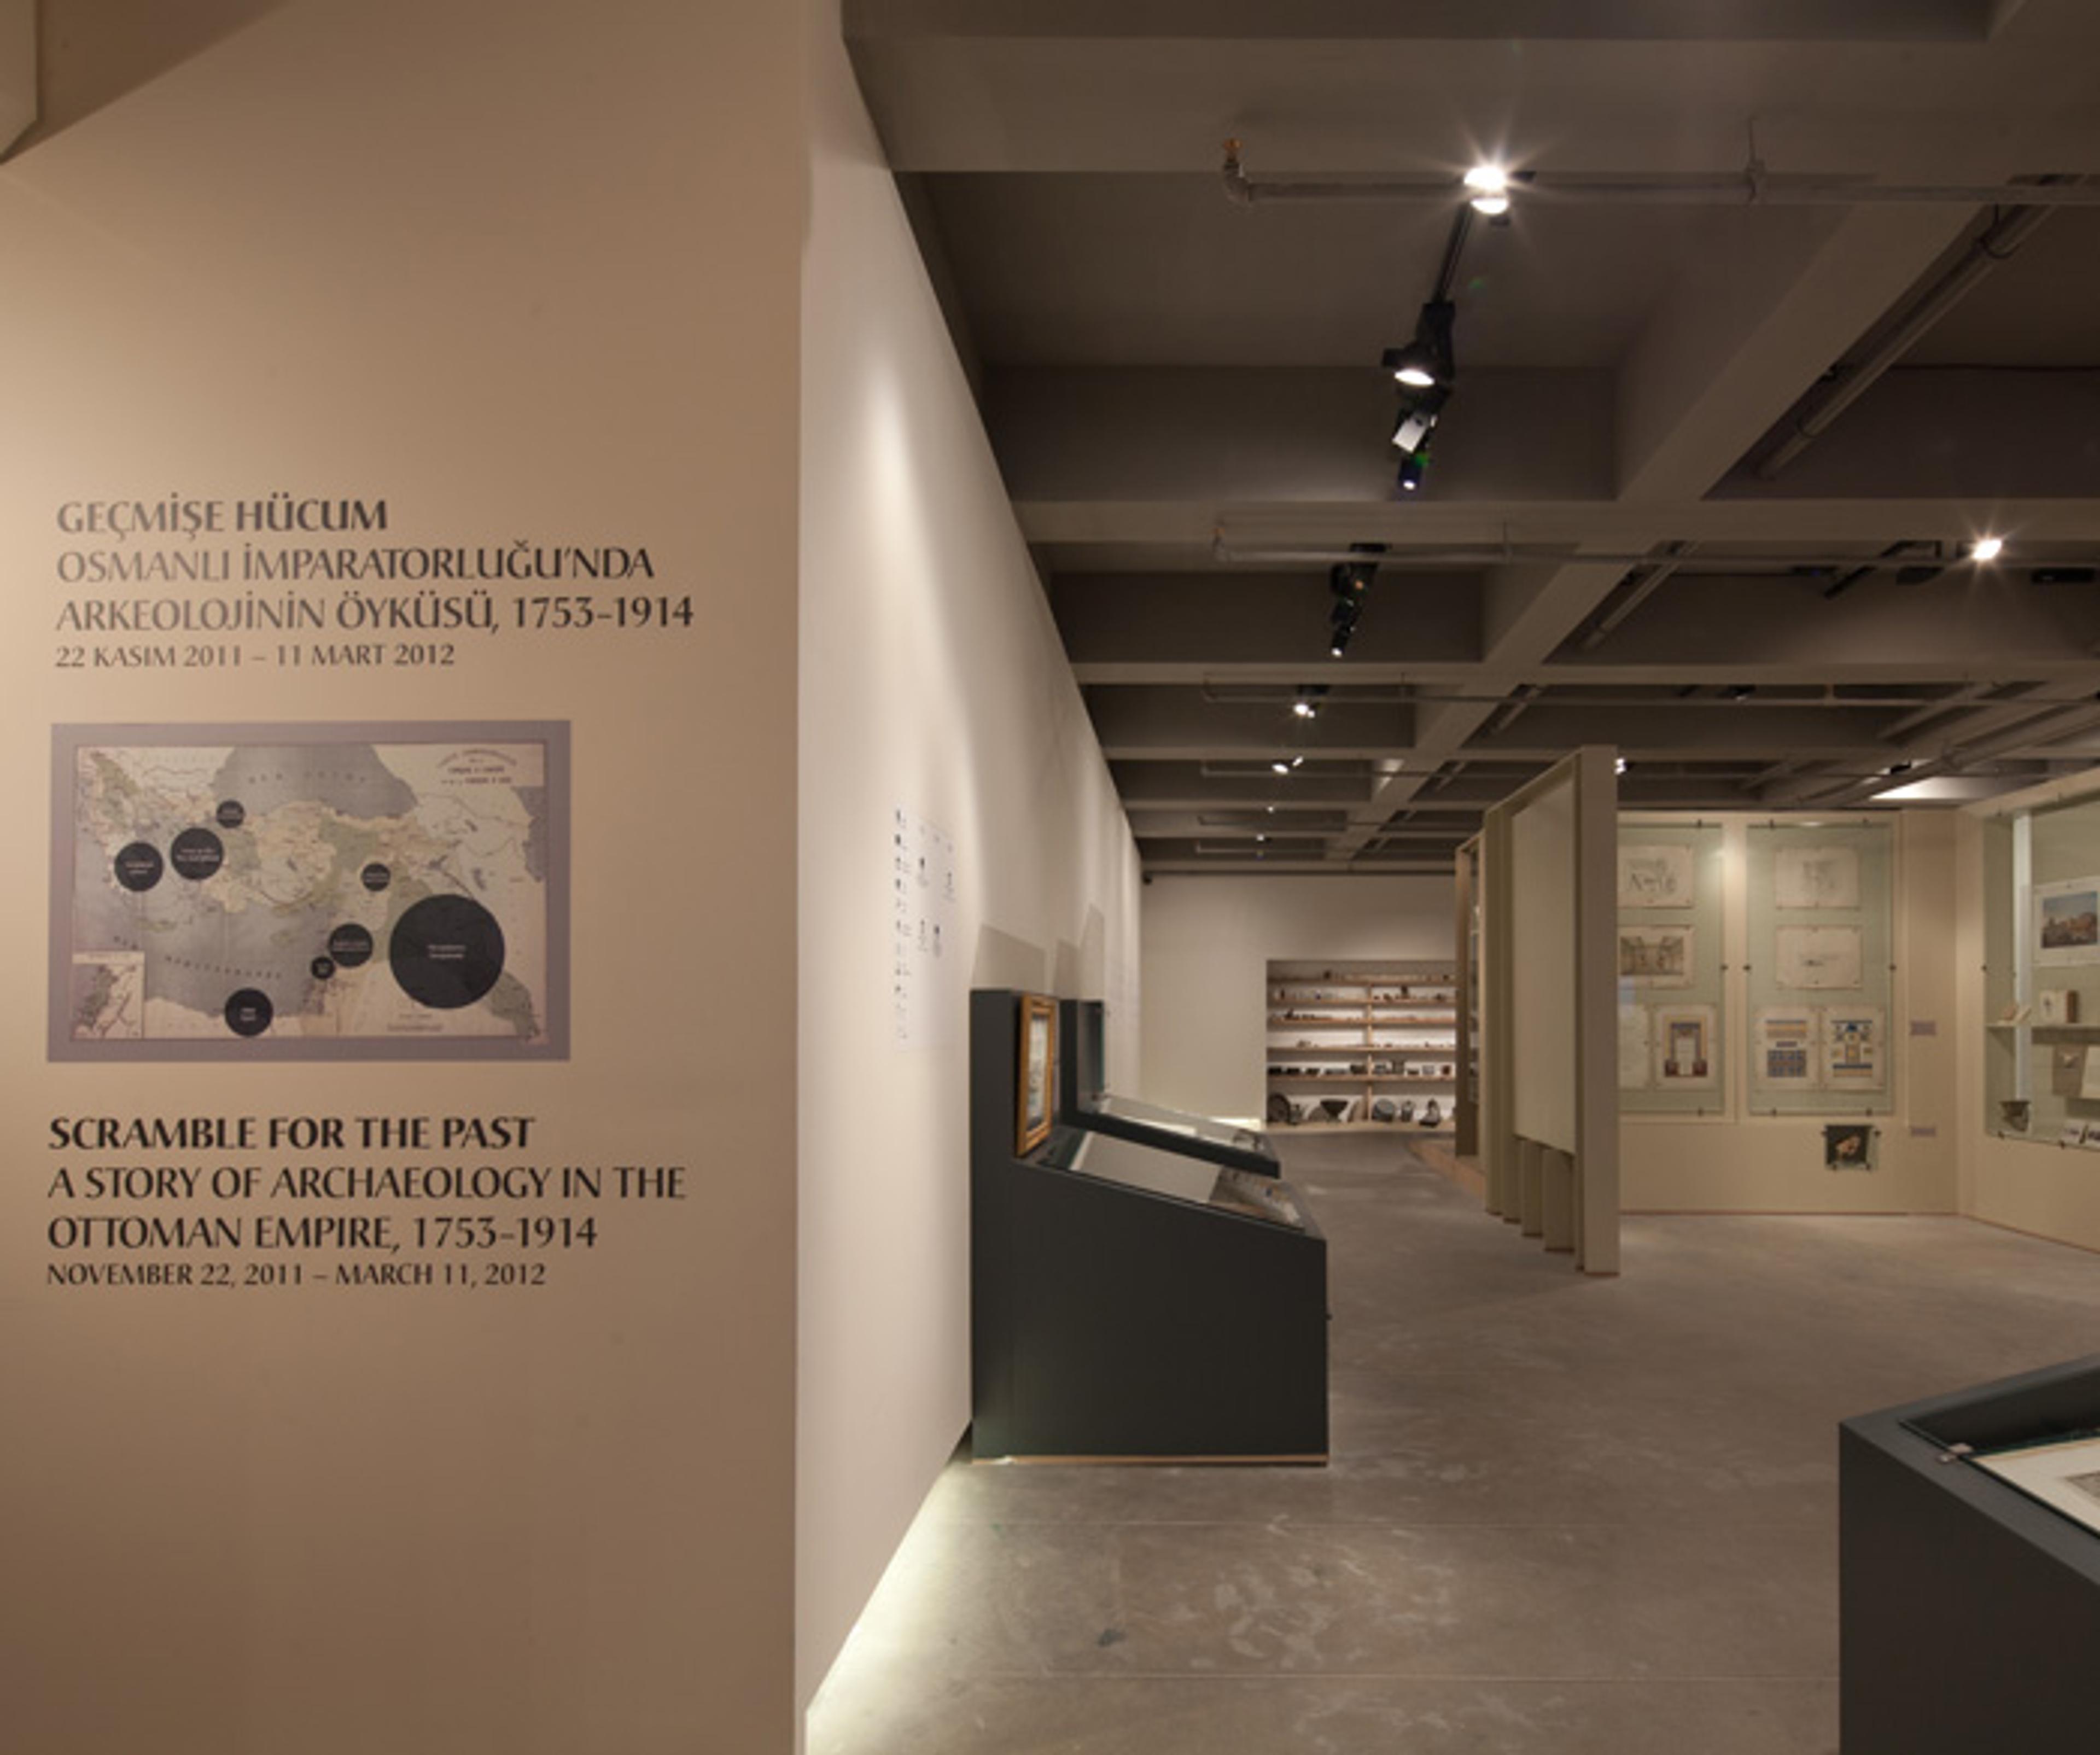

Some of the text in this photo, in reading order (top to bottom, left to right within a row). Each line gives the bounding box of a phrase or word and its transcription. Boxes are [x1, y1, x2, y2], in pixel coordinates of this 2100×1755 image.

[57, 492, 388, 540] GEÇMİŞE HÜCUM
[56, 550, 229, 582] OSMANLI
[56, 590, 325, 631] ARKEOLOJİNİN
[336, 588, 499, 634] ÖYKÜSÜ,
[55, 646, 85, 668] 22
[94, 646, 176, 668] KASIM
[184, 645, 241, 667] 2011
[278, 645, 301, 666] 11
[312, 644, 384, 666] MART
[394, 643, 455, 666] 2012
[48, 1116, 536, 1151] SCRAMBLE FOR THE PAST
[47, 1166, 686, 1200] A STORY OF ARCHAEOLOGY IN THE
[47, 1215, 242, 1250] OTTOMAN
[254, 1215, 401, 1255] EMPIRE,
[46, 1263, 194, 1286] NOVEMBER
[200, 1263, 236, 1288] 22,
[243, 1263, 302, 1286] 2011
[335, 1262, 433, 1286] MARCH
[444, 1263, 477, 1289] 11,
[484, 1262, 546, 1286] 2012
